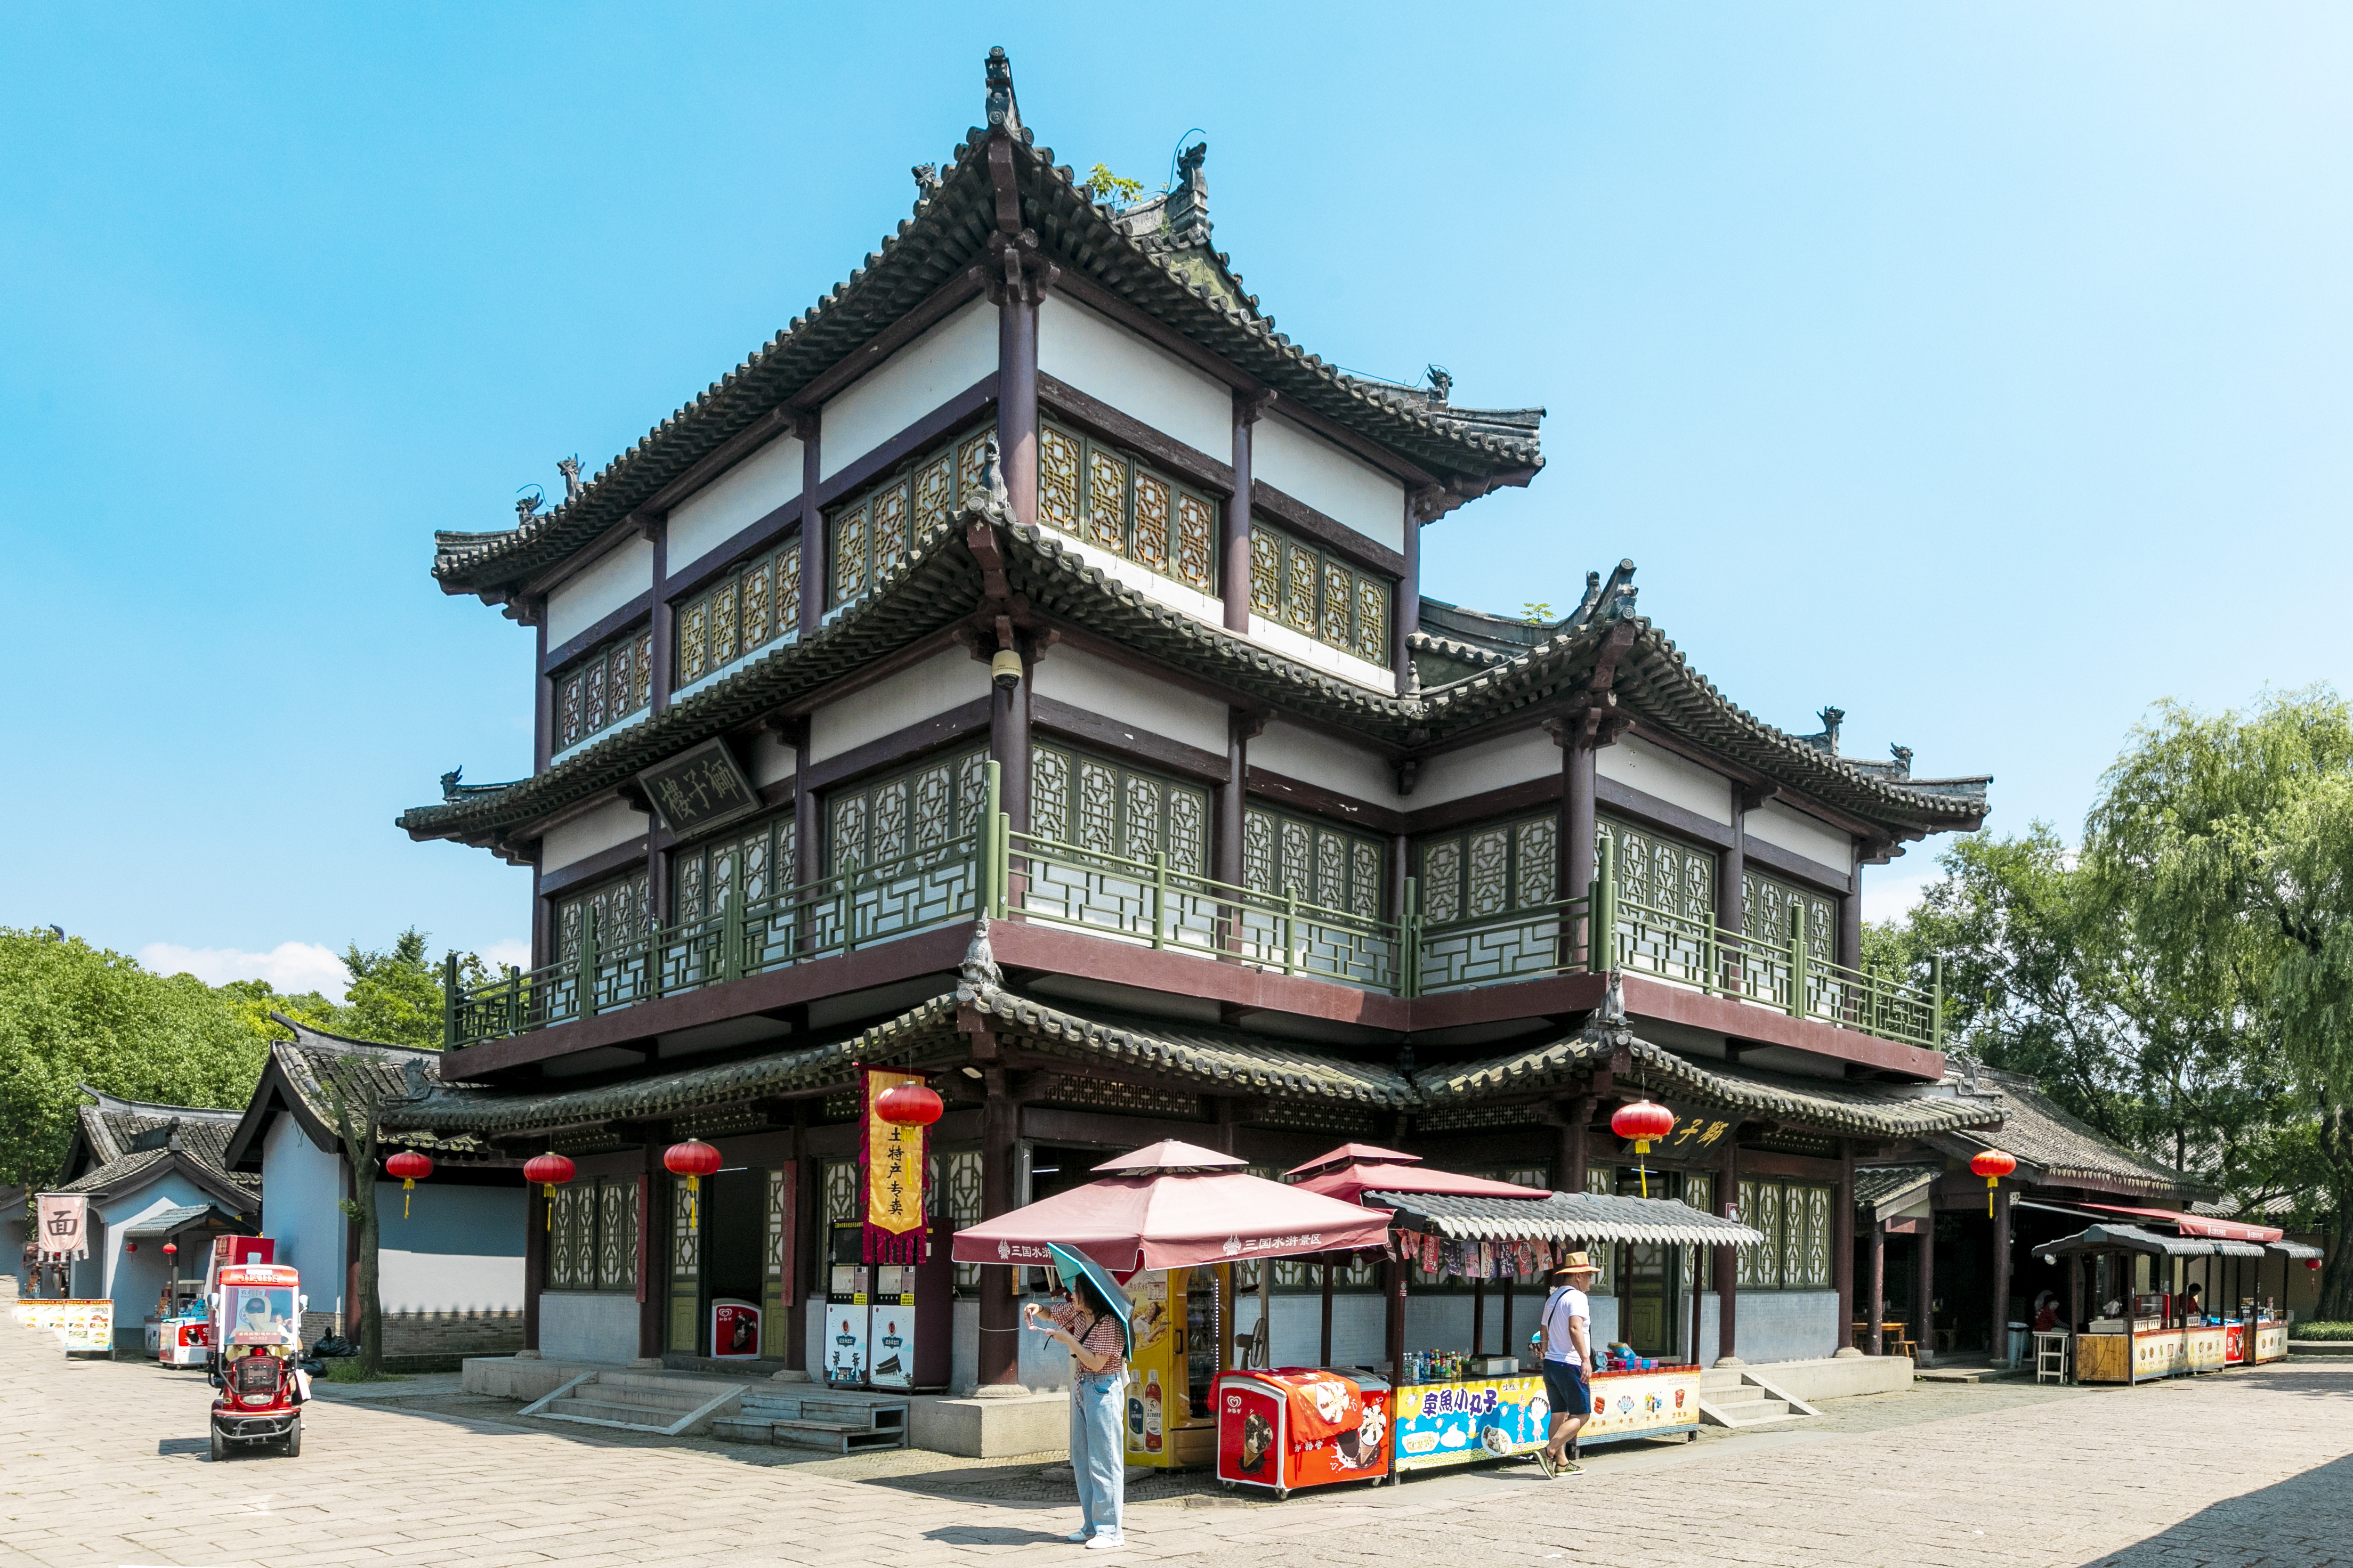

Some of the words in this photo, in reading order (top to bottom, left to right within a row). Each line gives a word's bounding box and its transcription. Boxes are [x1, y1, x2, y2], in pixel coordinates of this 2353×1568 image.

[886, 1127, 905, 1216] 土特产专卖
[47, 1210, 77, 1236] 面
[1243, 1233, 1322, 1250] 三国水浒景区
[1422, 1388, 1497, 1417] 章魚小丸子
